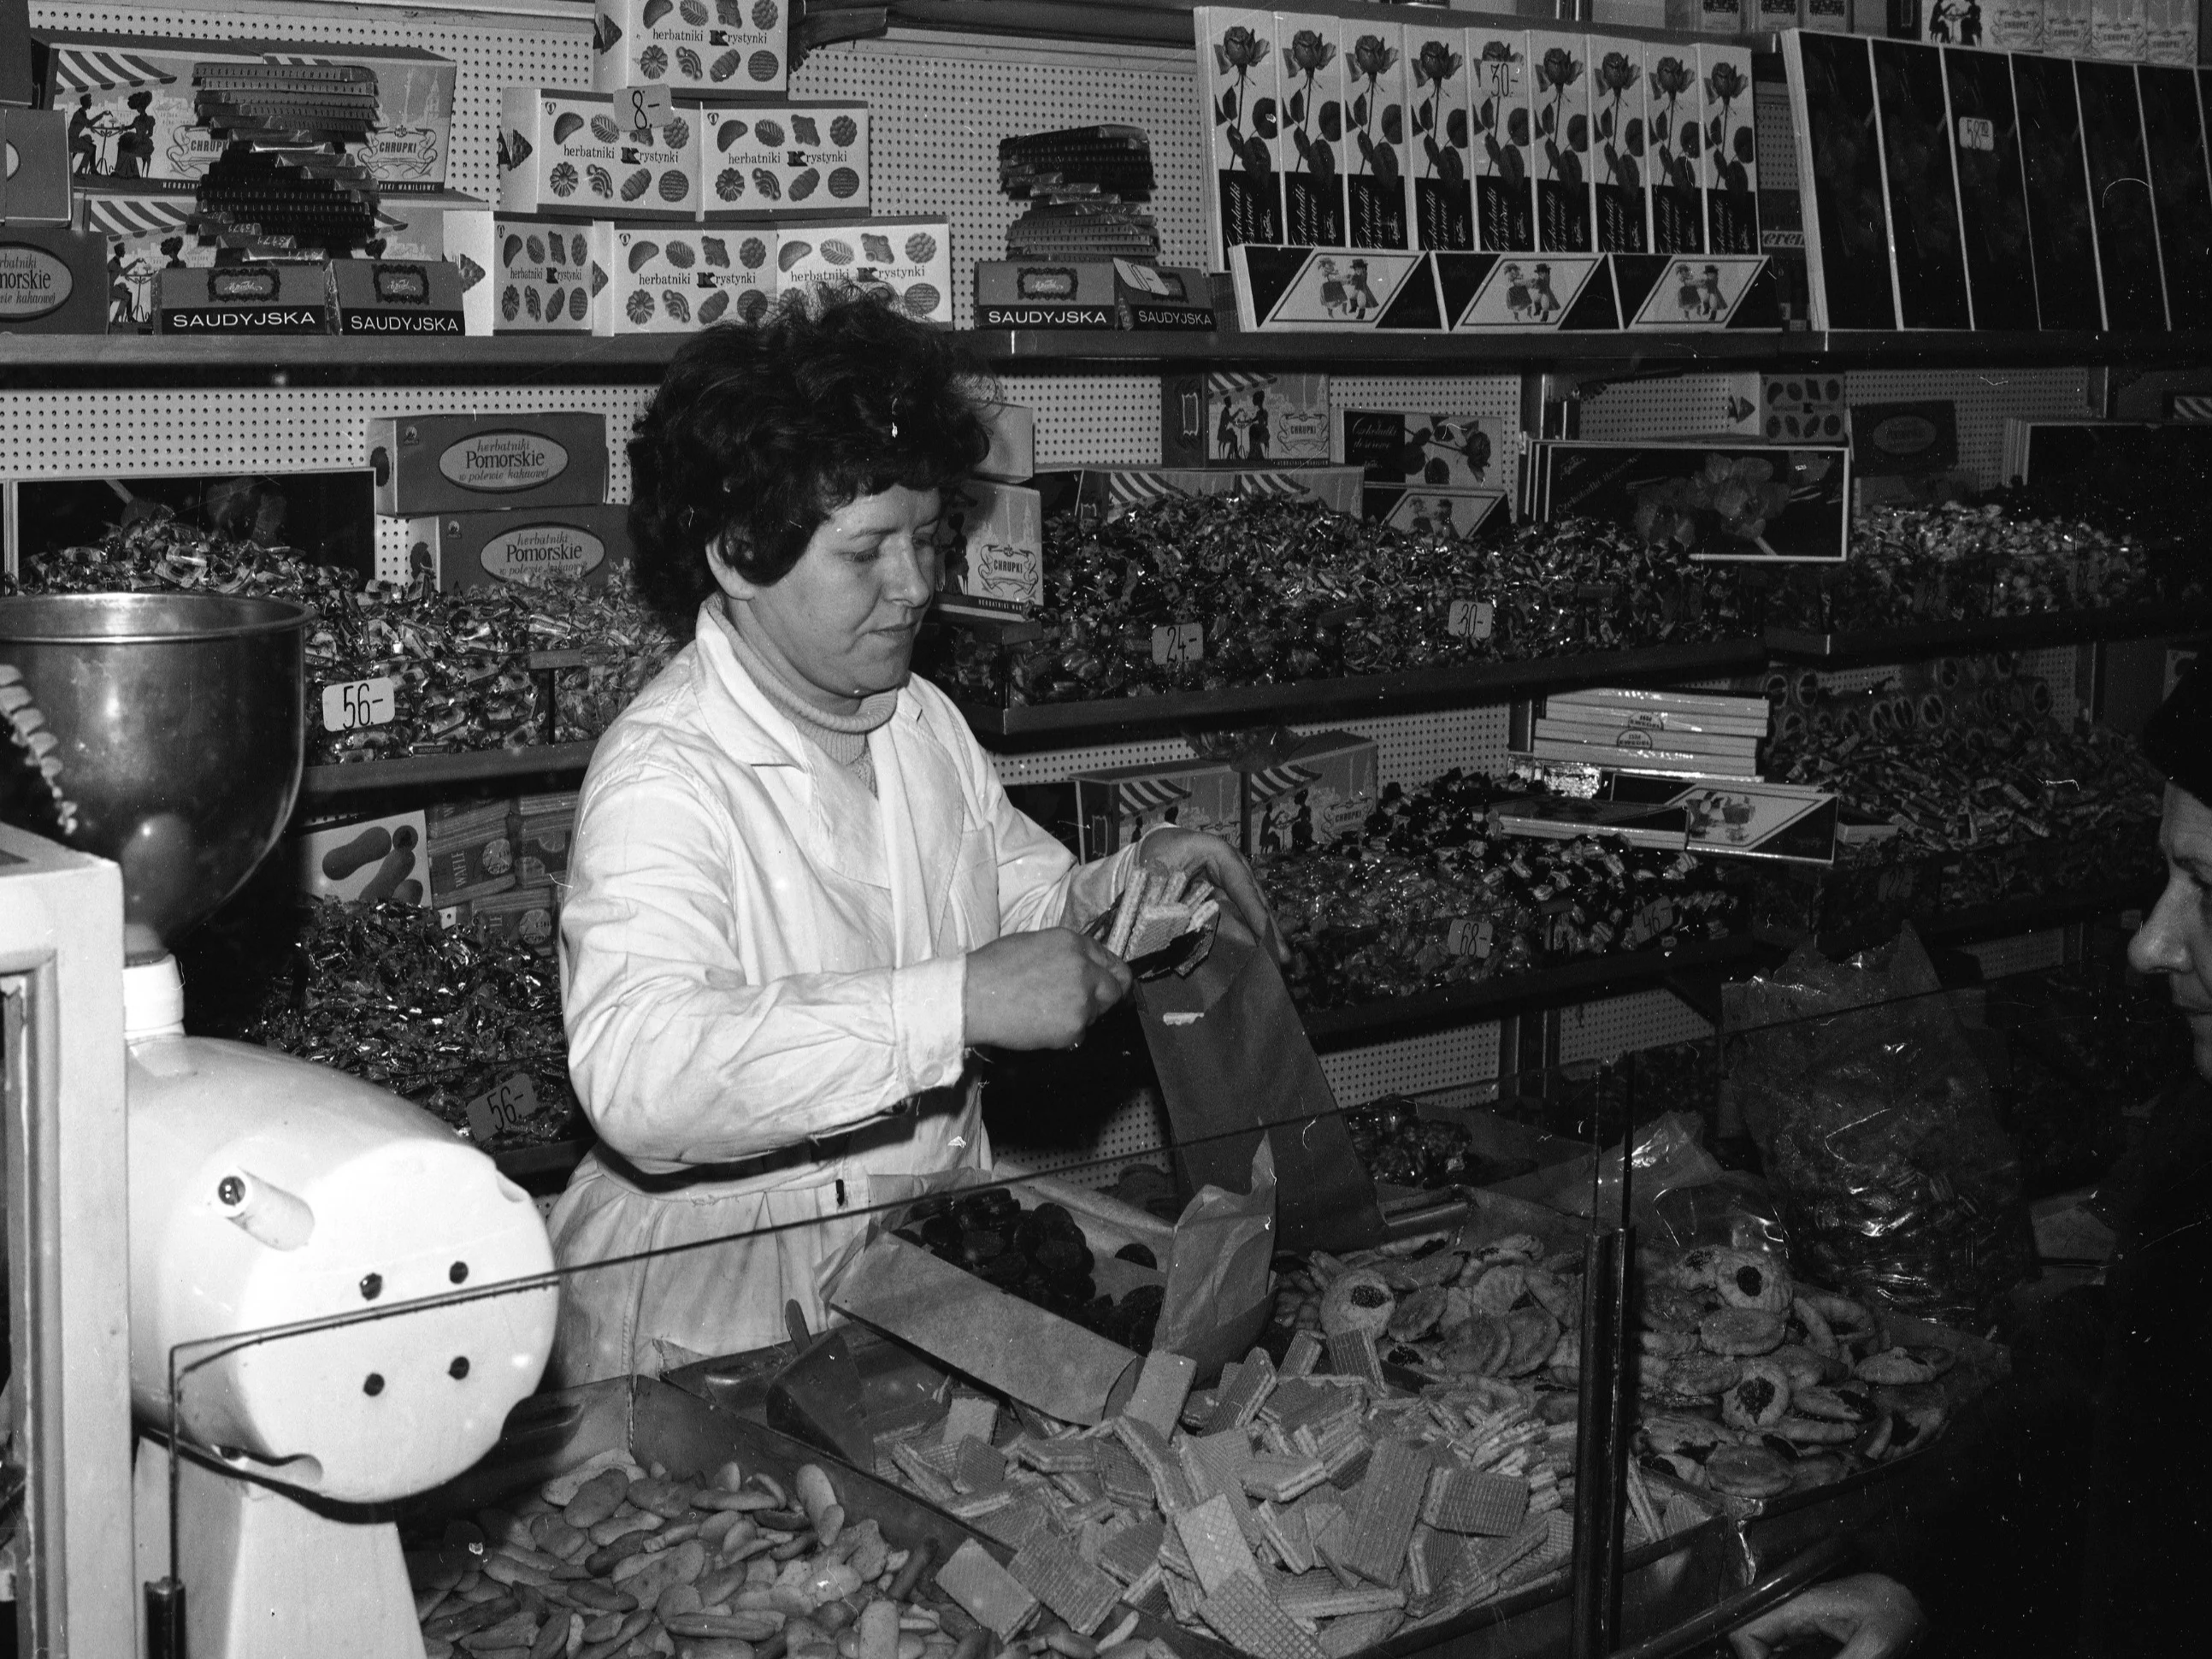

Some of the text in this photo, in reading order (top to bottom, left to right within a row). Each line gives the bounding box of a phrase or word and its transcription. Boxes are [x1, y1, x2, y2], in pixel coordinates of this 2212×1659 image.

[652, 29, 768, 45] herbatniki Krystynki
[379, 142, 417, 153] CHRUPKI
[563, 145, 679, 164] herbatniki Krystynki
[728, 151, 847, 167] herbatniki Krystynki
[0, 253, 37, 269] rbatniki
[0, 269, 51, 289] morskie
[510, 267, 581, 284] herbatniki Krystynki
[639, 272, 756, 288] herbatniki Krystynki
[791, 267, 925, 284] herbatniki Krystynki
[173, 312, 316, 328] SAUDYJSKA
[351, 316, 458, 331] SAUDYJSKA
[988, 310, 1106, 323] SAUDYJSKA
[1138, 310, 1212, 325] SAUDYJSKA
[1290, 425, 1317, 434] CHRUPKI
[477, 439, 530, 452] herbatniki
[466, 451, 545, 469] Pomorskie
[468, 470, 504, 482] polewie
[517, 531, 568, 546] herbatniki
[506, 543, 582, 563] Pomorskie
[994, 559, 1023, 574] CHRUPKI
